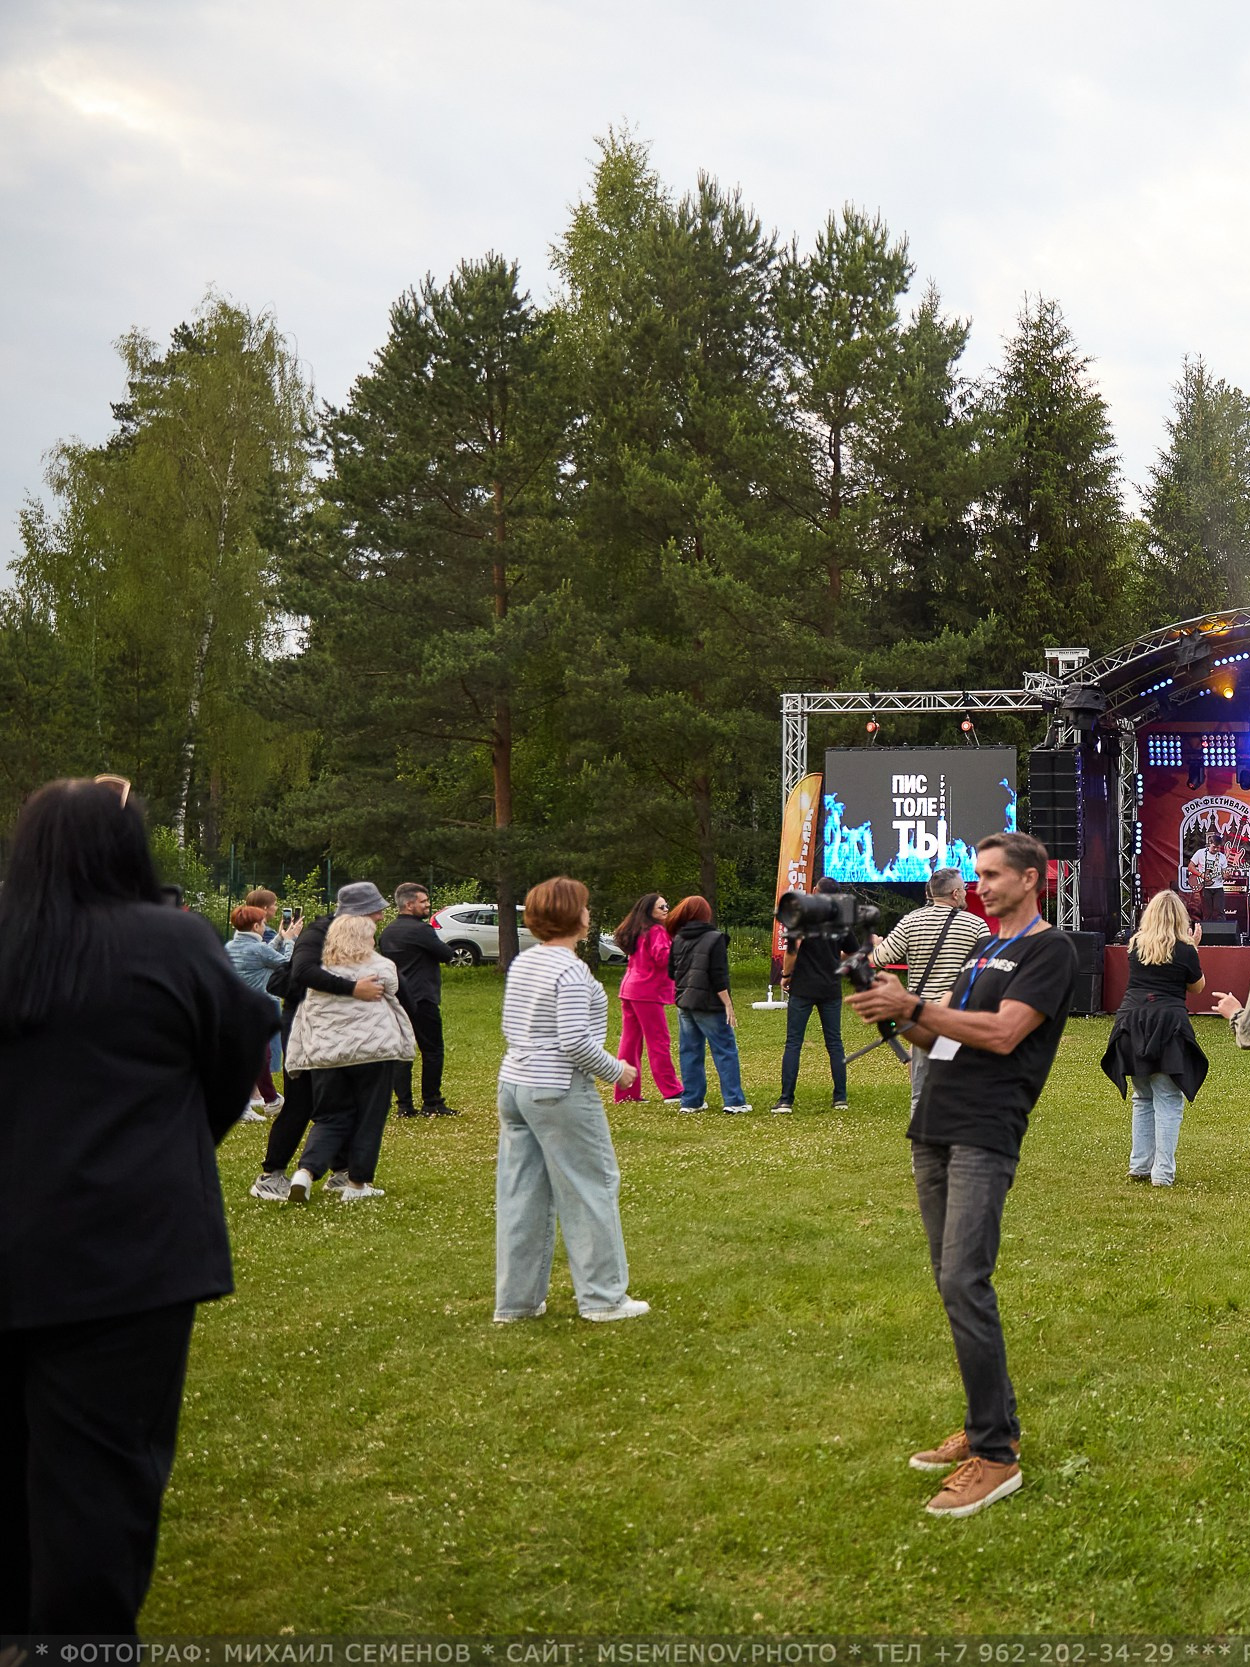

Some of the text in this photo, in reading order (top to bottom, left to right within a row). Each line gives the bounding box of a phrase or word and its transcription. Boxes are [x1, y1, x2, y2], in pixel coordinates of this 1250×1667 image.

[892, 774, 928, 794] ПИС
[892, 797, 938, 817] ТОЛЕ
[1184, 797, 1250, 814] РОК-ФЕСТИВАЛЬ
[892, 820, 947, 859] ТЫ
